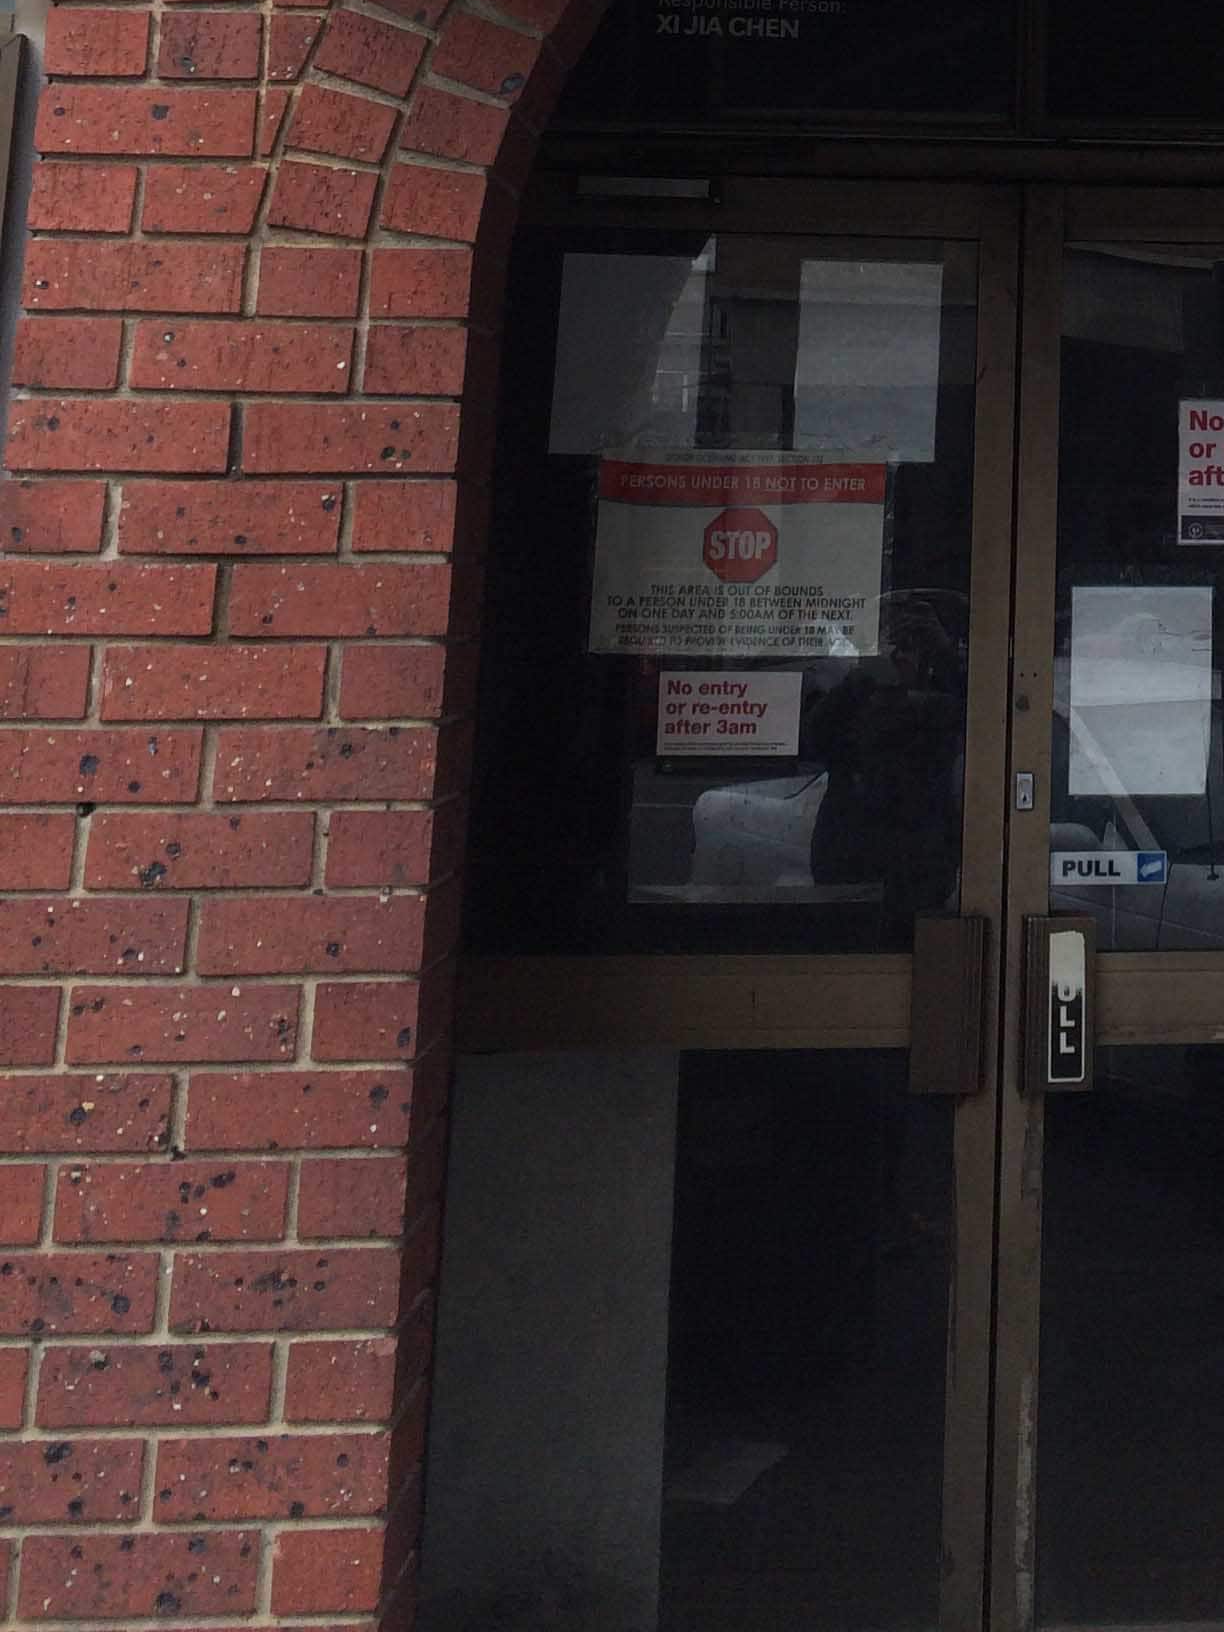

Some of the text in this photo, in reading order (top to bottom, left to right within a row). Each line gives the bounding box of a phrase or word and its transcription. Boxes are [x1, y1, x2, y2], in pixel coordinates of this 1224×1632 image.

[655, 13, 800, 39] XI JIA CHEN
[1189, 410, 1224, 432] No
[1189, 441, 1217, 459] or
[620, 474, 866, 491] PERSONS UNDER 18 NOT TO ENTER
[708, 531, 772, 561] STOP
[651, 585, 824, 597] THIS AREA IS OUT OF BOUNDS
[607, 596, 866, 609] TO A PERSON UNDER 18 BETWEEN MIDNIGHT
[617, 607, 638, 618] ON
[641, 608, 669, 618] ONE
[671, 608, 696, 619] DAY
[699, 608, 726, 619] AND
[778, 609, 795, 620] OF
[797, 609, 817, 620] THE
[667, 680, 748, 699] No entry
[665, 701, 768, 718] or re-entry
[664, 719, 757, 735] after 3am
[1061, 859, 1121, 877] PULL
